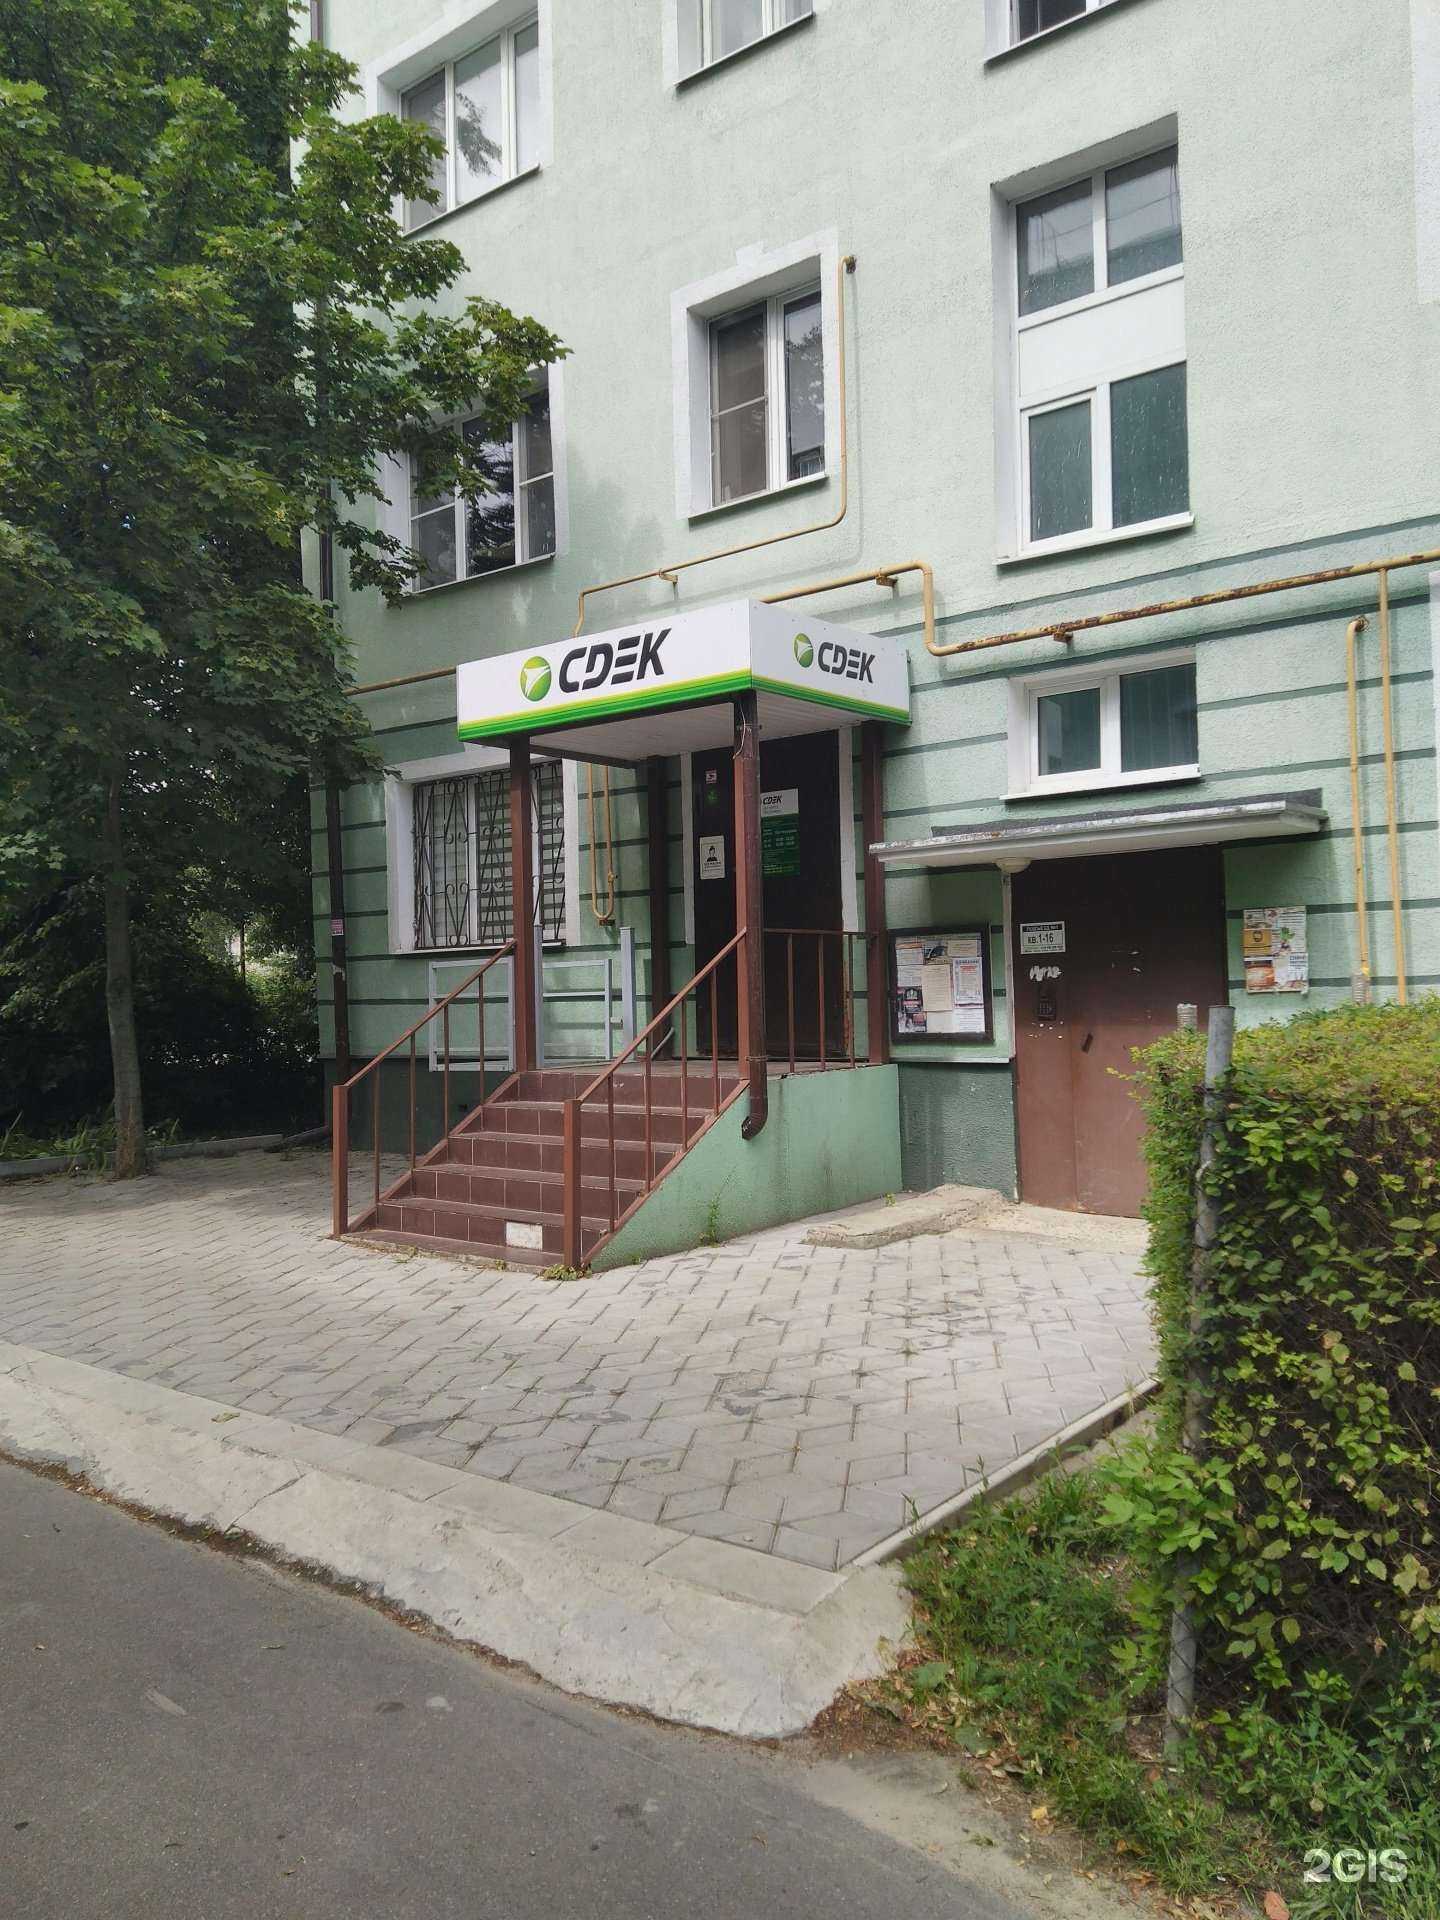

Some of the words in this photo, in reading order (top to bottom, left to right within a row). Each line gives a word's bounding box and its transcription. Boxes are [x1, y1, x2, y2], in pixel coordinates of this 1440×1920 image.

[558, 628, 673, 693] CDEK
[817, 641, 876, 684] CDEK
[762, 795, 783, 805] CDEK
